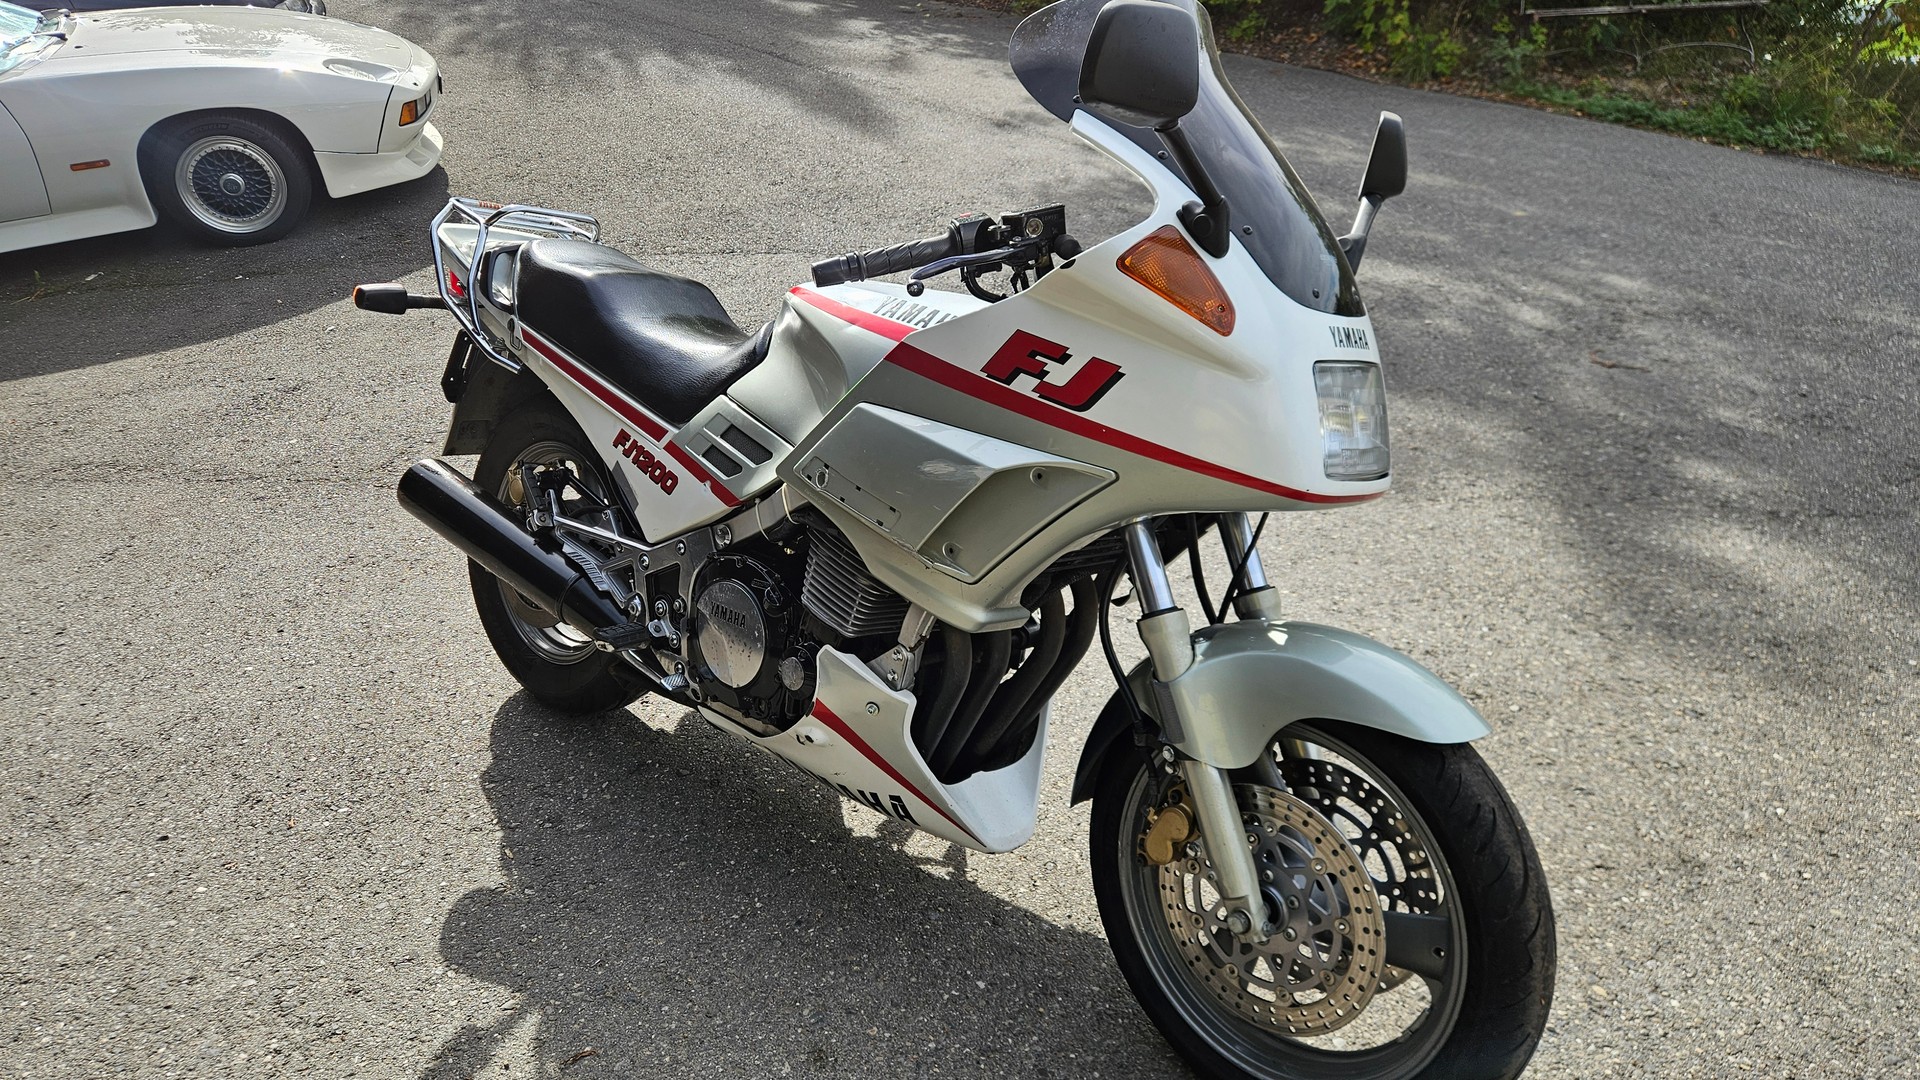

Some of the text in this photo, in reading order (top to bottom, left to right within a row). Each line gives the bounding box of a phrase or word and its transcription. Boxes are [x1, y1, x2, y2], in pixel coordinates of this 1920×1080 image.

[1328, 326, 1370, 351] YAMAHA
[980, 328, 1126, 412] FJ
[612, 428, 679, 496] FJ1200
[711, 601, 746, 629] YAMAHA
